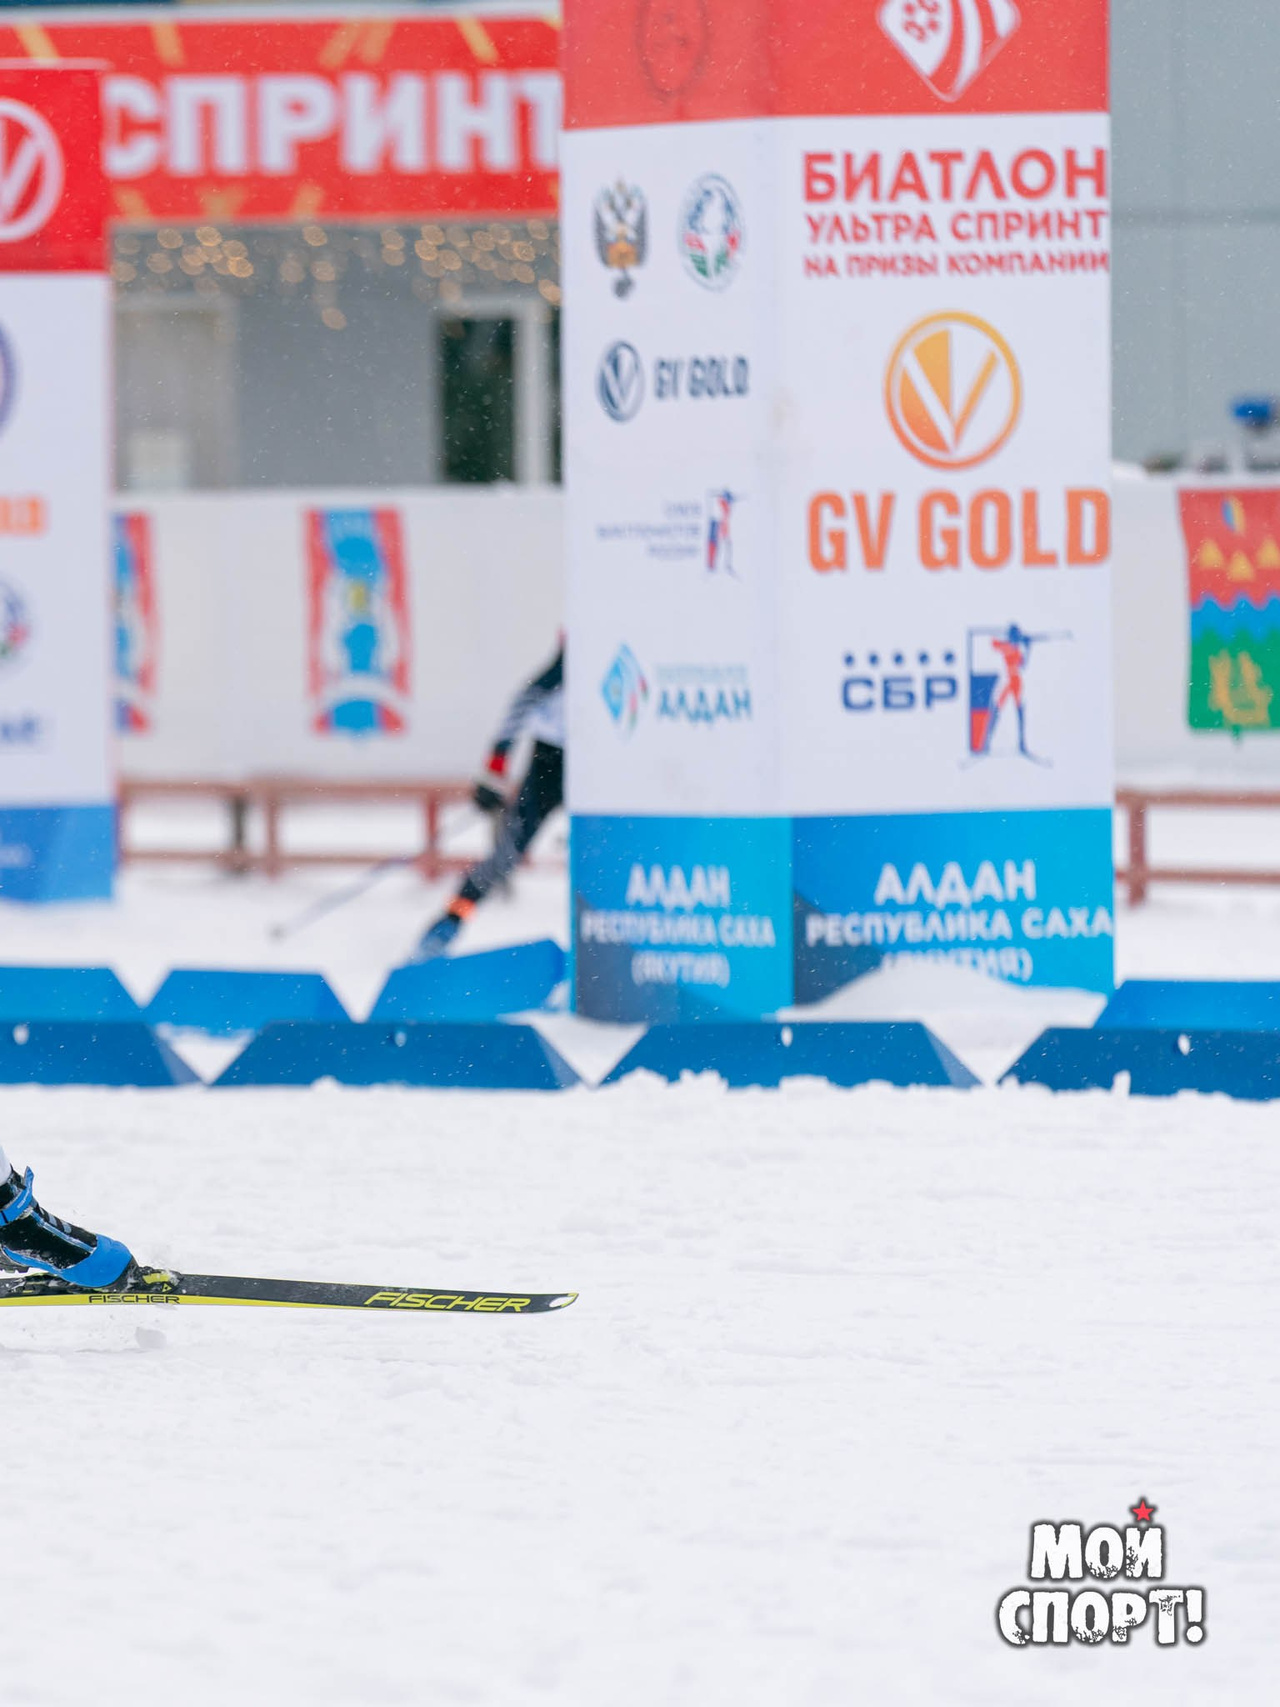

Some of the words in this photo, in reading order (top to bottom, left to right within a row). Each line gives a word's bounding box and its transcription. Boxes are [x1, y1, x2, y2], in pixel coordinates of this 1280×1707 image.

[103, 71, 562, 177] СПРИНТ
[804, 148, 1107, 201] БИАТЛОН
[806, 212, 936, 243] УЛЬТРА
[950, 209, 1108, 241] СПРИНТ
[804, 254, 839, 277] НА
[847, 253, 938, 277] ПРИЗЫ
[947, 251, 1109, 276] КОМПАНИИ
[807, 489, 896, 573] GV
[919, 487, 1112, 571] GOLD
[841, 676, 959, 712] СБР
[625, 863, 731, 911] АЛДАН
[874, 859, 1036, 908] АЛДАН
[806, 909, 1013, 947] РЕСПУБЛИКА
[1021, 906, 1112, 940] САХА
[88, 1294, 181, 1304] FISCHER
[364, 1291, 531, 1313] FISCHER
